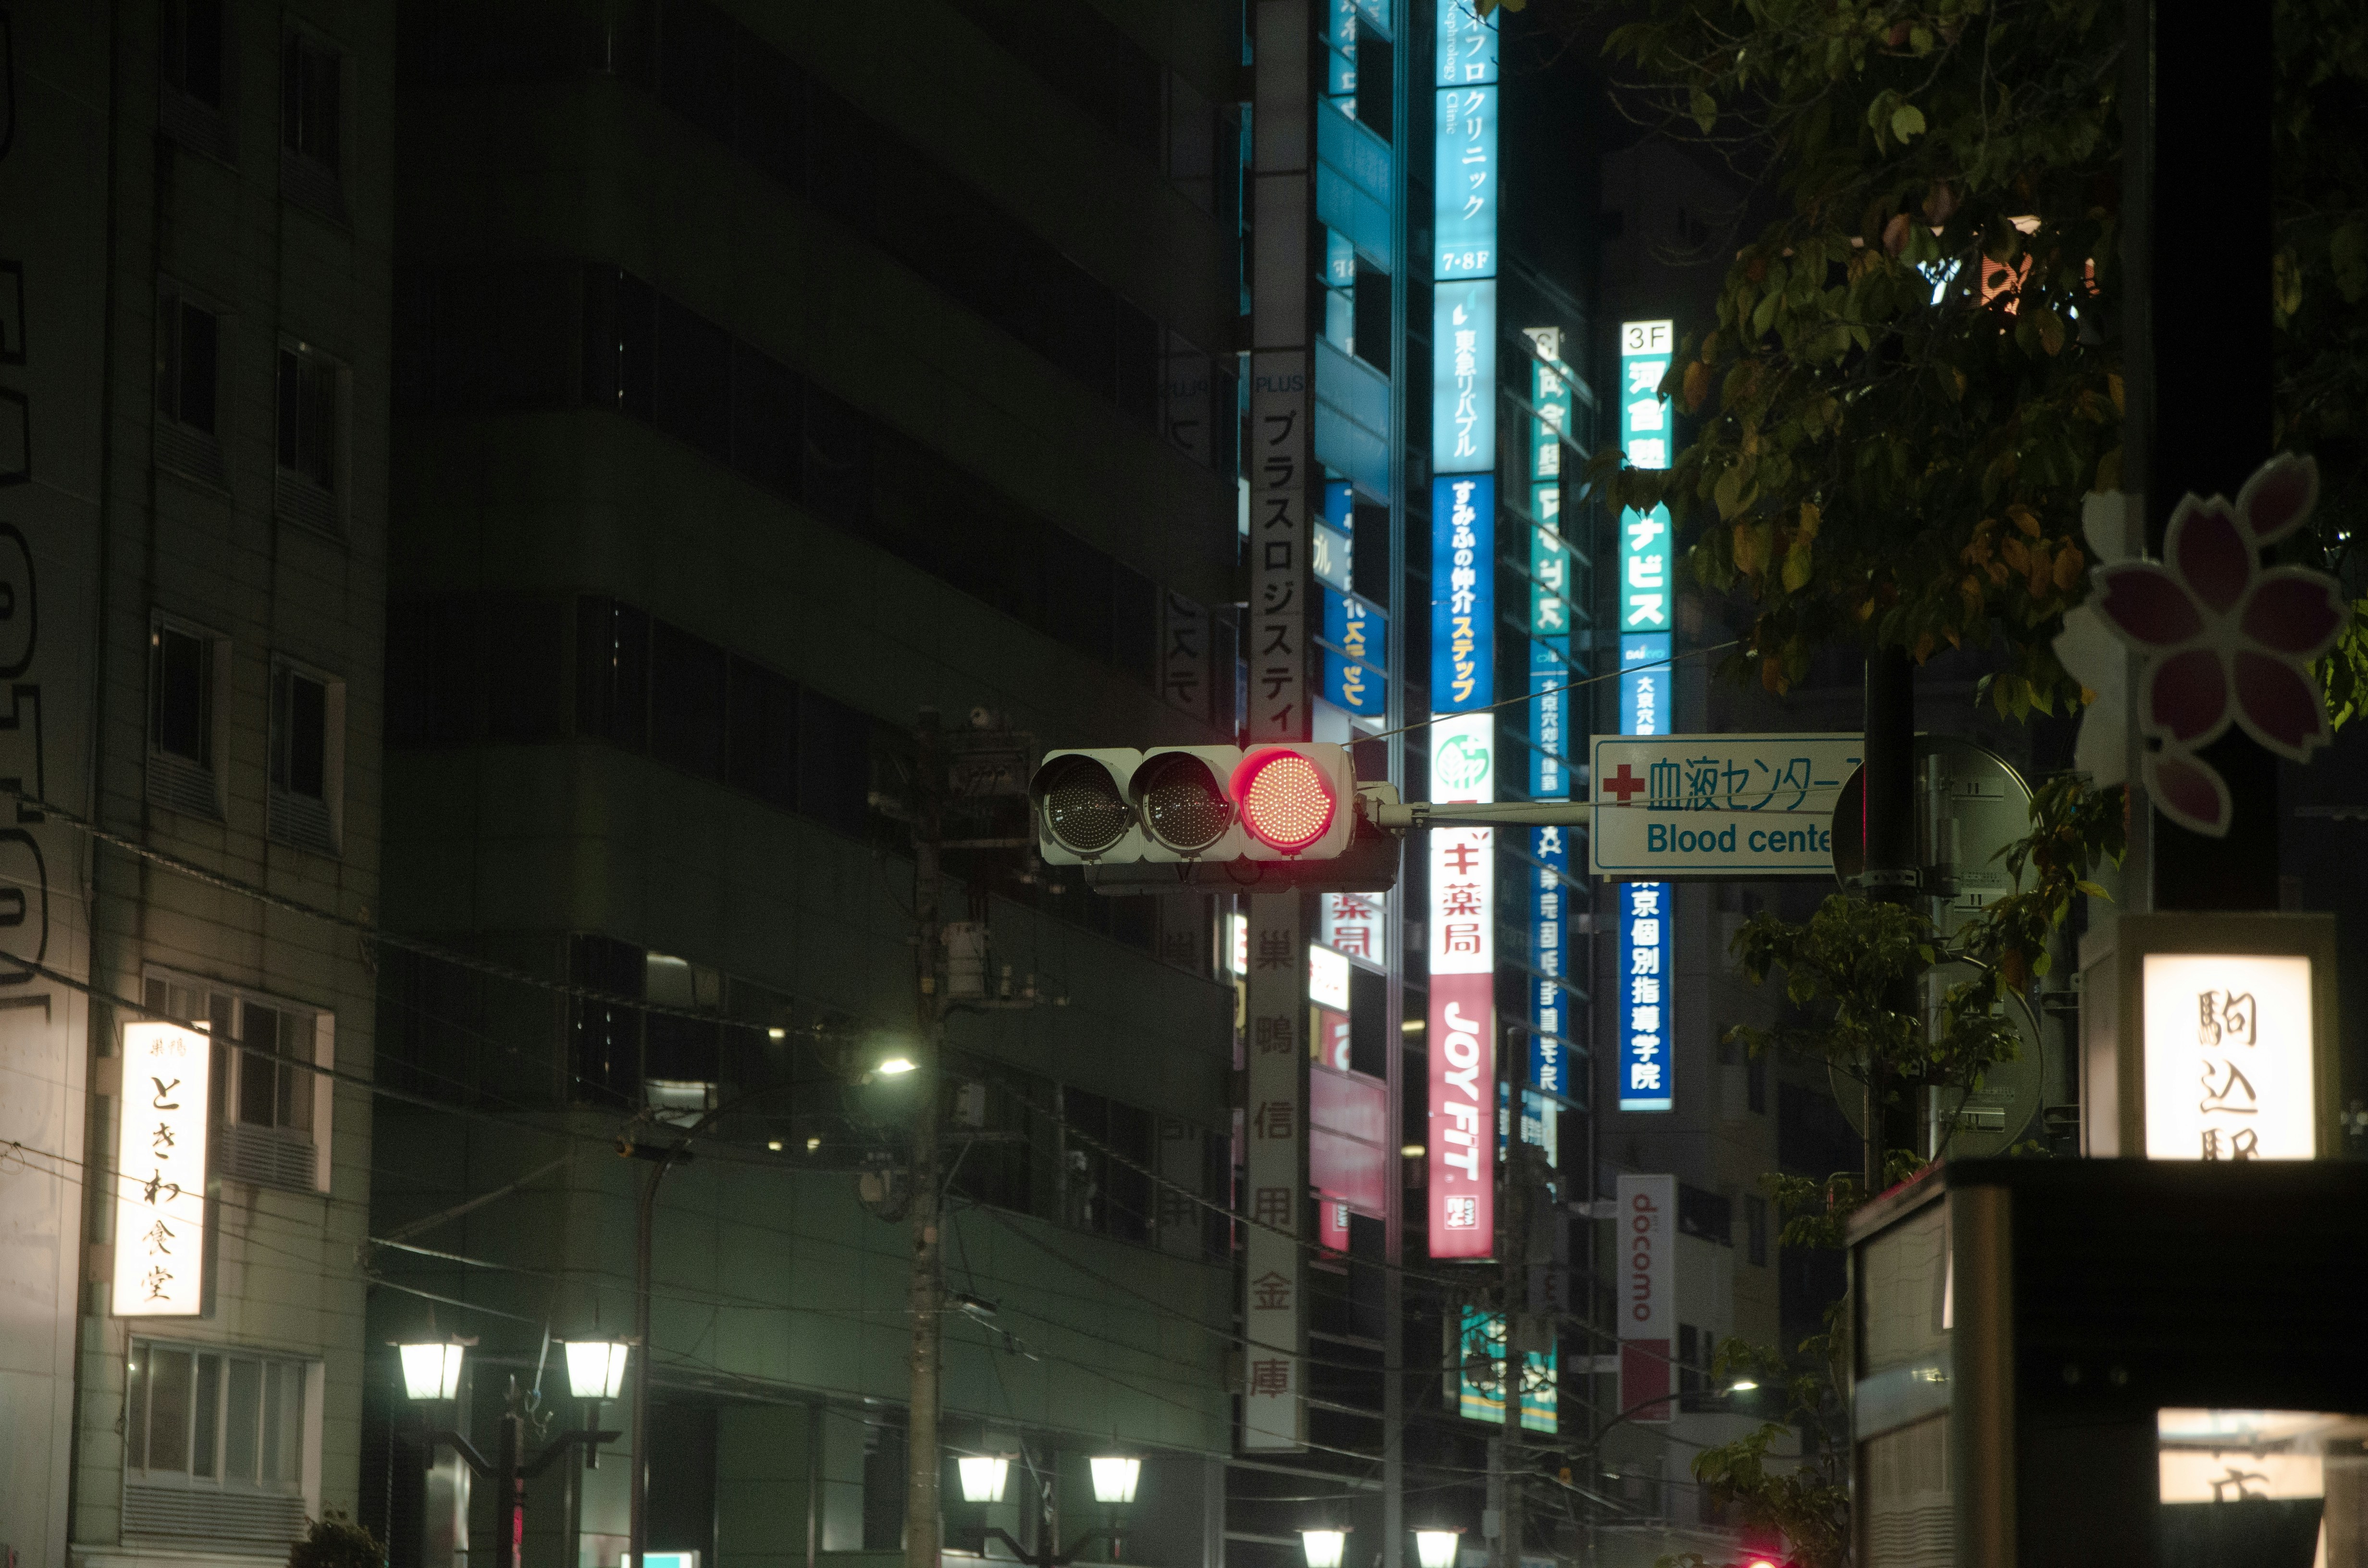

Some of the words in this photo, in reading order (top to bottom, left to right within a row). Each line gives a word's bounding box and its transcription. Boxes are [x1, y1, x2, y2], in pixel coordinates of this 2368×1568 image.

[1446, 92, 1459, 135] Clinic
[1629, 326, 1665, 349] 3F
[1255, 375, 1305, 393] PLUS
[1454, 329, 1477, 457] 東急リバブル
[1647, 756, 1862, 811] 血液センター
[1647, 823, 1736, 853] Blood
[1630, 883, 1660, 1090] 京個別指導学院
[142, 1077, 181, 1302] ときわ食堂
[1251, 929, 1293, 1398] 巣鴨信用金庫
[1633, 1193, 1658, 1322] docomo
